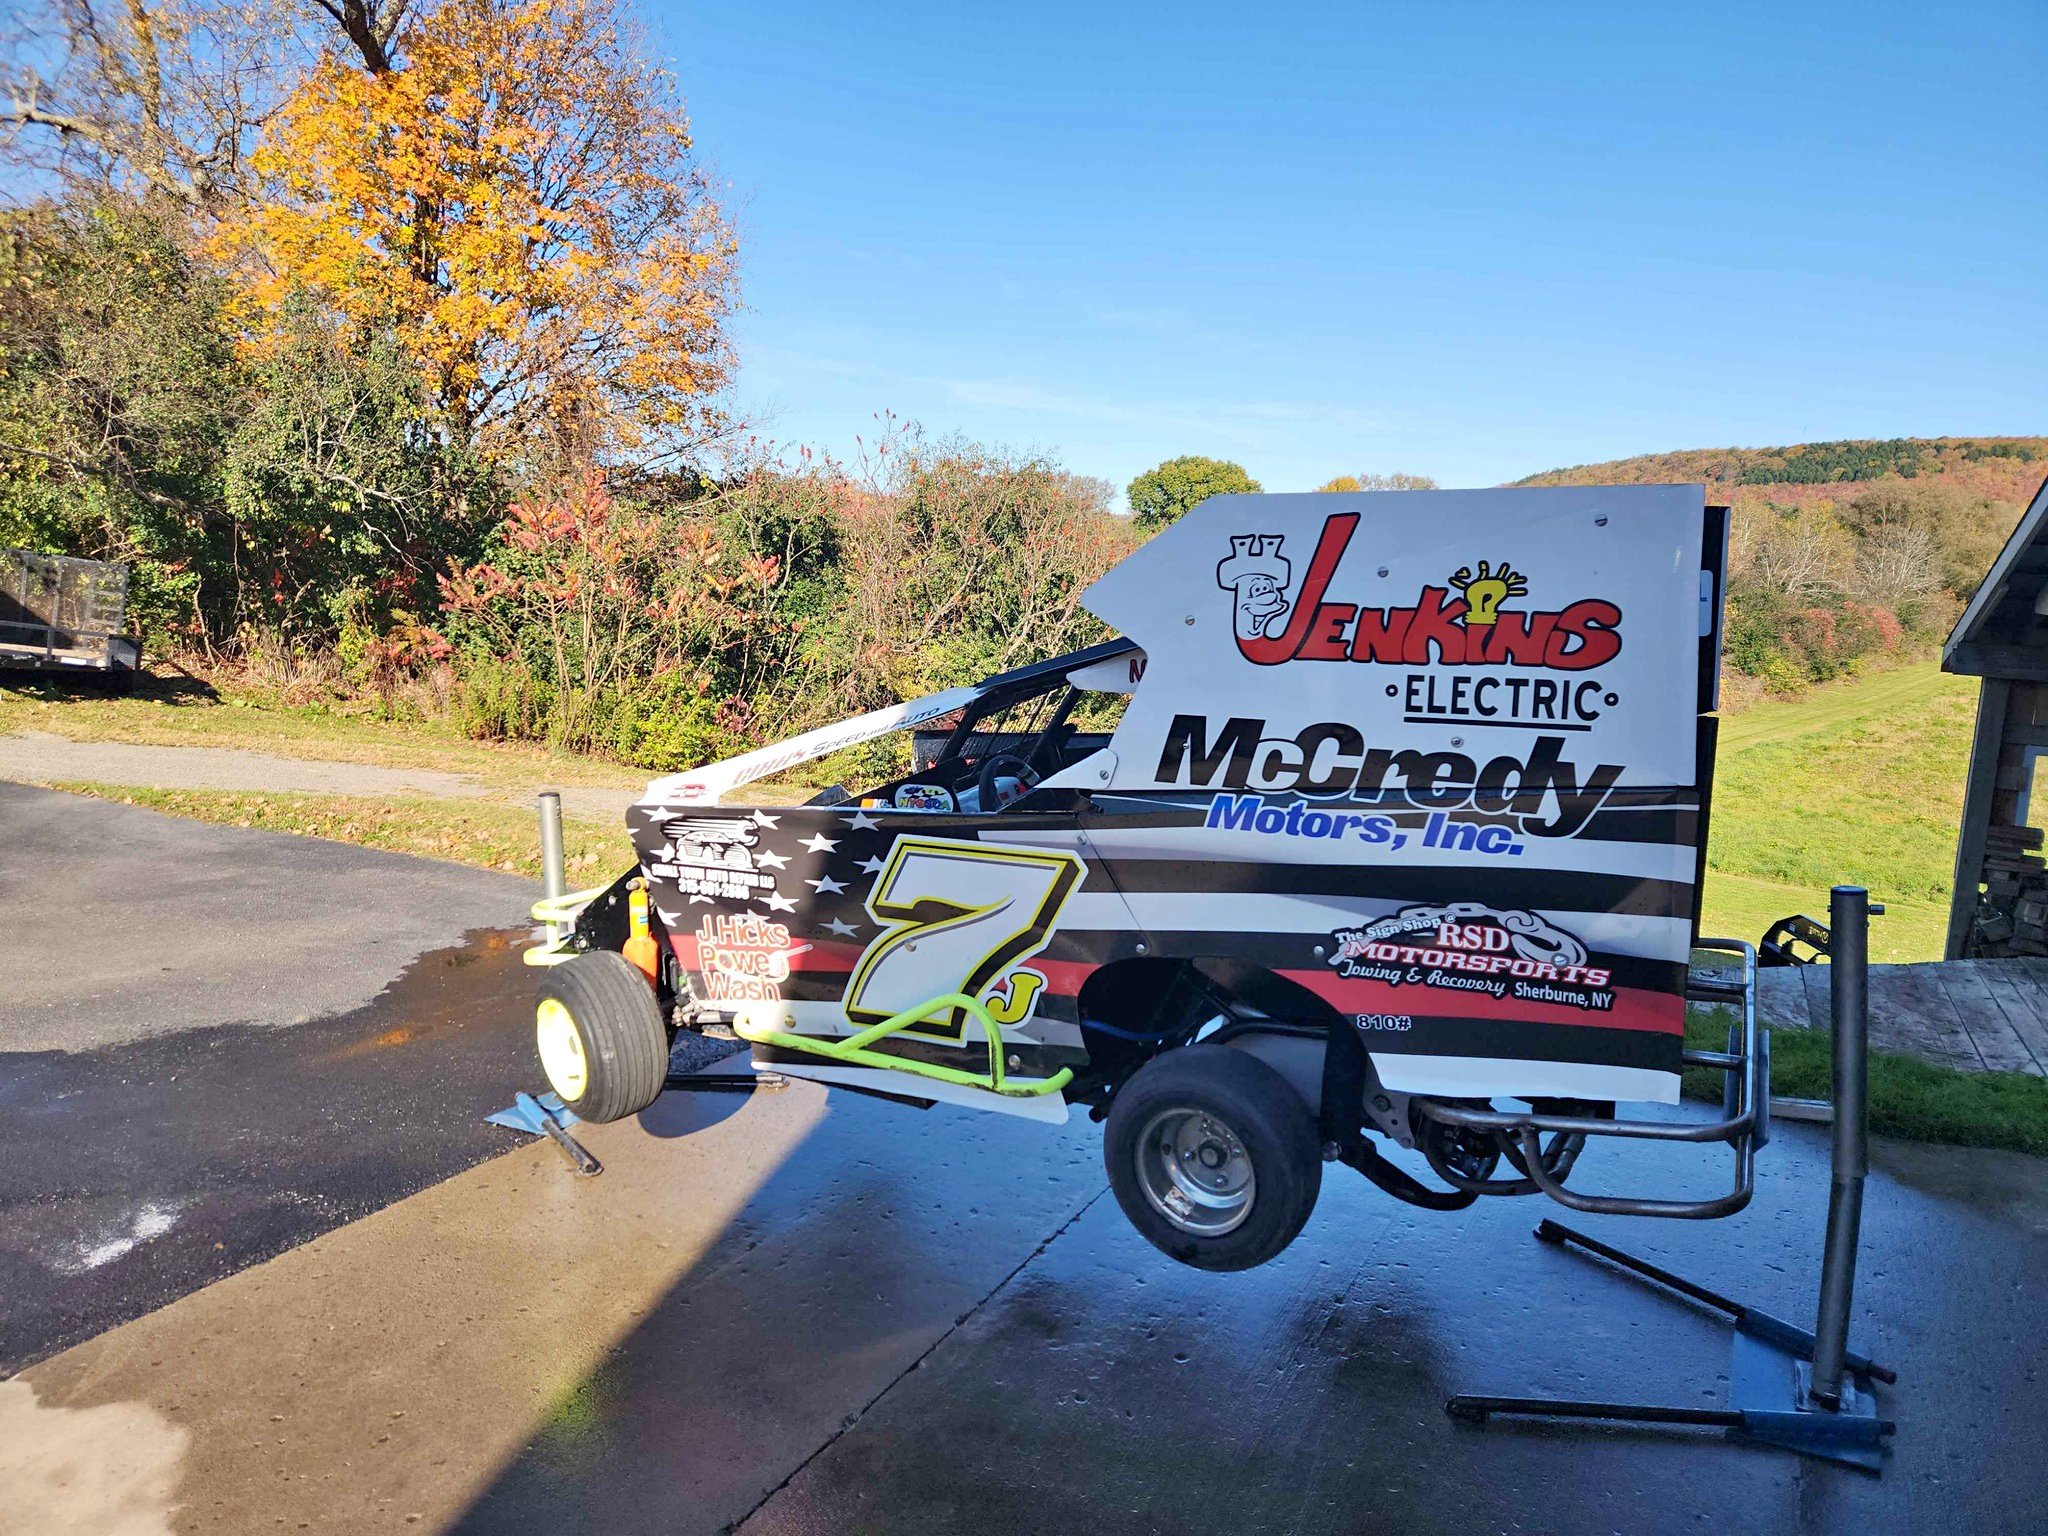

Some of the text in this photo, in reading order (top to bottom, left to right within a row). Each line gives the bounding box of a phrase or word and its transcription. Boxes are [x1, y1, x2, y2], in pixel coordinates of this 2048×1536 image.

[1405, 675, 1603, 721] ELECTRIC
[1154, 714, 1626, 838] McCredy
[1205, 794, 1524, 855] Motors, Inc.
[1335, 931, 1363, 943] The
[1366, 924, 1400, 939] Sign
[1402, 917, 1441, 932] Shop
[1437, 922, 1509, 951] RSD
[1340, 959, 1612, 1009] Towing & Recovery Sherburne, NY
[1345, 941, 1611, 986] MOTORSPORTS
[702, 972, 781, 1001] Wash
[1357, 1014, 1412, 1031] 810#
